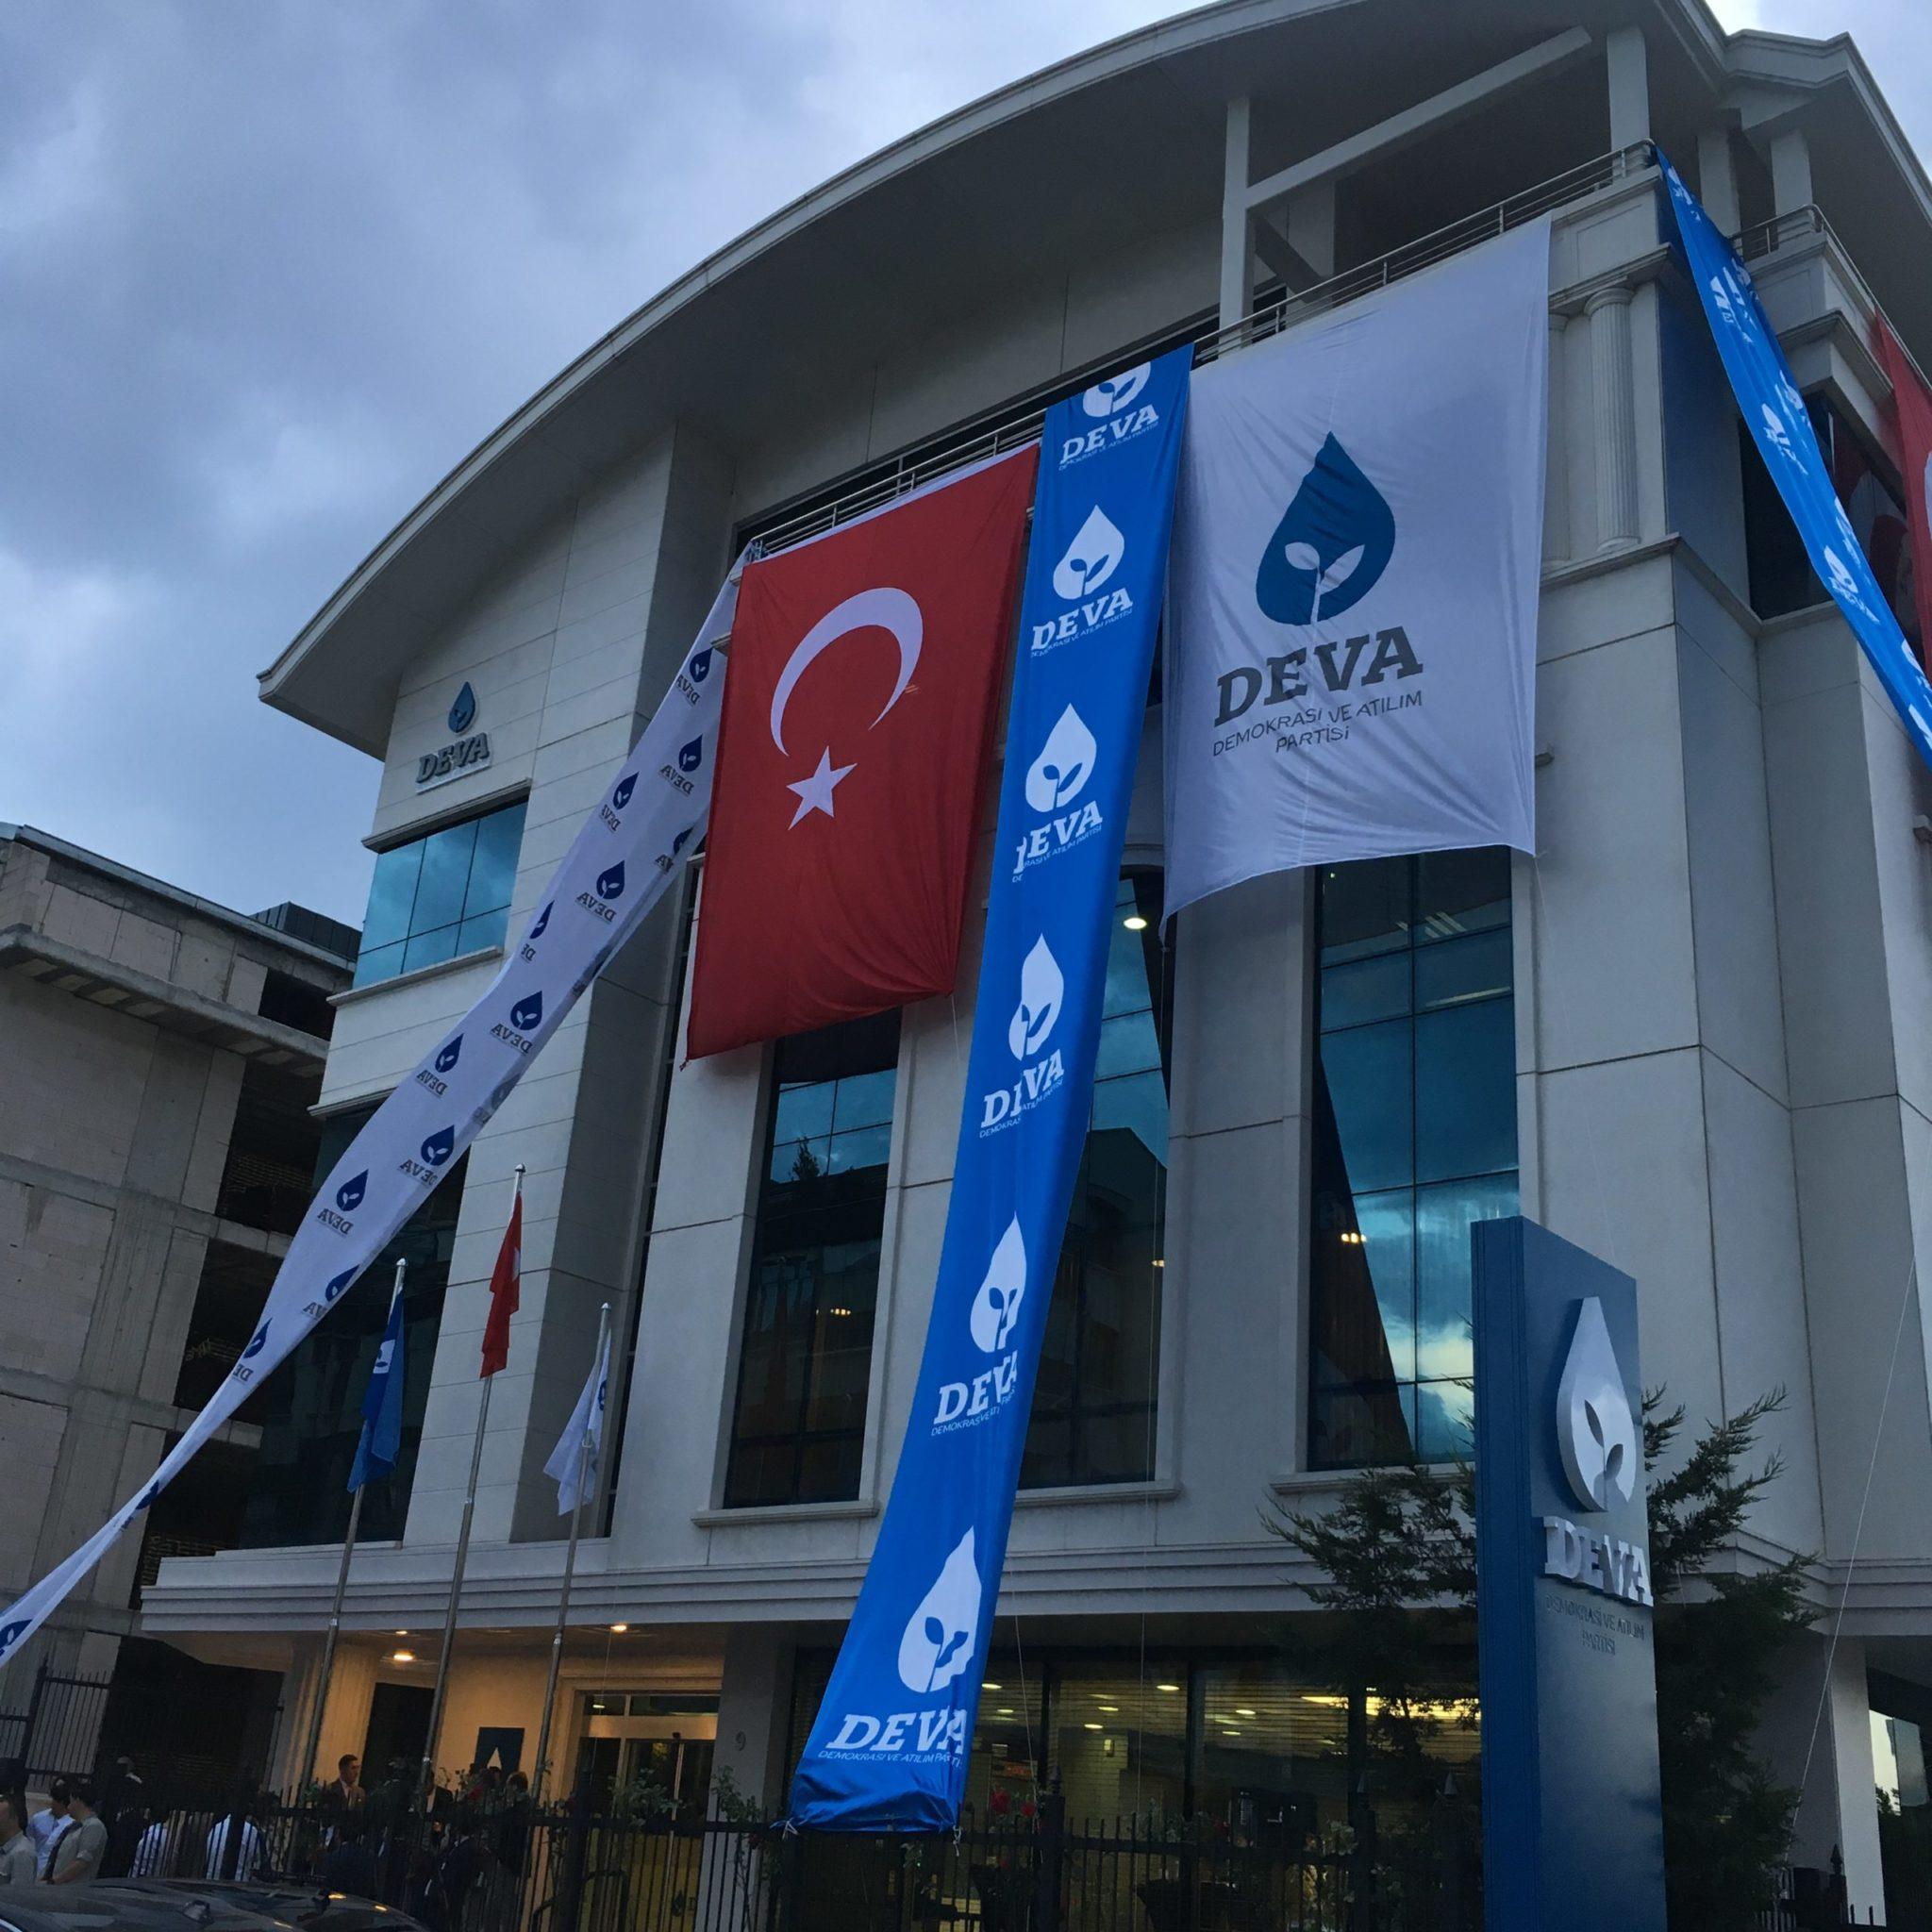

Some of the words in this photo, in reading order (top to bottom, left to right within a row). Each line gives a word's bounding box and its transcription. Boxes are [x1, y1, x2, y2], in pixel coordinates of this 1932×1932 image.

[1059, 404, 1159, 465] DEVA
[1031, 588, 1133, 651] DEVA
[1214, 625, 1423, 727] DEVA
[1328, 704, 1352, 724] VE
[1356, 690, 1423, 717] ATILIM
[415, 732, 490, 784] DEVA
[933, 1350, 1018, 1424] DEVA
[1543, 1516, 1654, 1607] DEVA
[824, 1705, 968, 1756] DEVA
